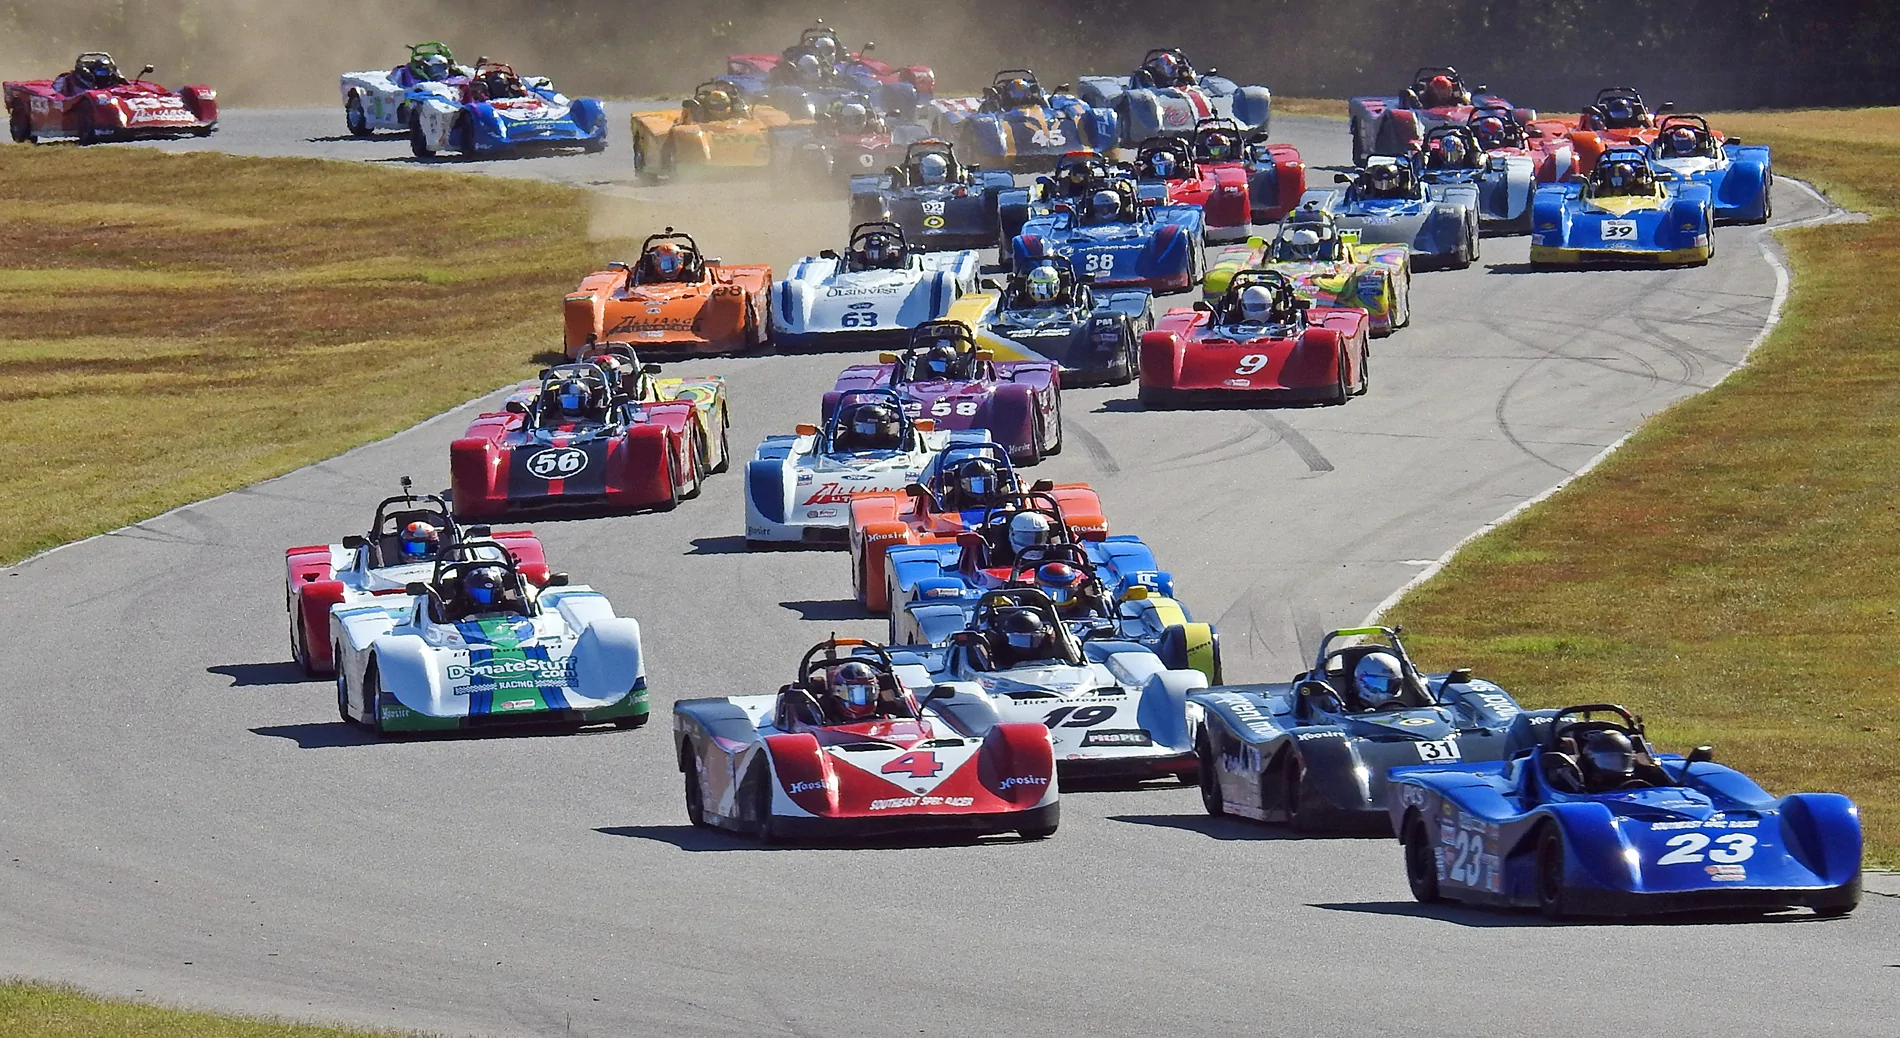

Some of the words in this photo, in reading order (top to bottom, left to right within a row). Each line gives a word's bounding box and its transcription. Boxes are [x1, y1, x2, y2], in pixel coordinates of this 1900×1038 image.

[1032, 130, 1066, 147] 45
[924, 201, 943, 212] 92
[1604, 226, 1633, 238] 39
[1085, 253, 1114, 271] 38
[841, 311, 879, 328] 63
[1095, 318, 1113, 326] PM
[1234, 354, 1269, 375] 9
[930, 401, 978, 417] 58
[535, 451, 581, 474] 56
[447, 656, 579, 680] DonateStuff
[537, 668, 578, 680] .com
[499, 680, 535, 691] RACING
[1013, 699, 1049, 707] Elite
[1055, 696, 1129, 705] Autosport
[1042, 705, 1118, 730] 19
[1421, 741, 1455, 760] 31
[880, 750, 944, 779] 4
[999, 774, 1048, 791] Hoosier
[869, 796, 921, 811] SOUTHEAST
[919, 796, 944, 806] SPEC
[944, 796, 975, 807] RACER
[1656, 832, 1758, 866] 23
[1449, 830, 1484, 887] 23
